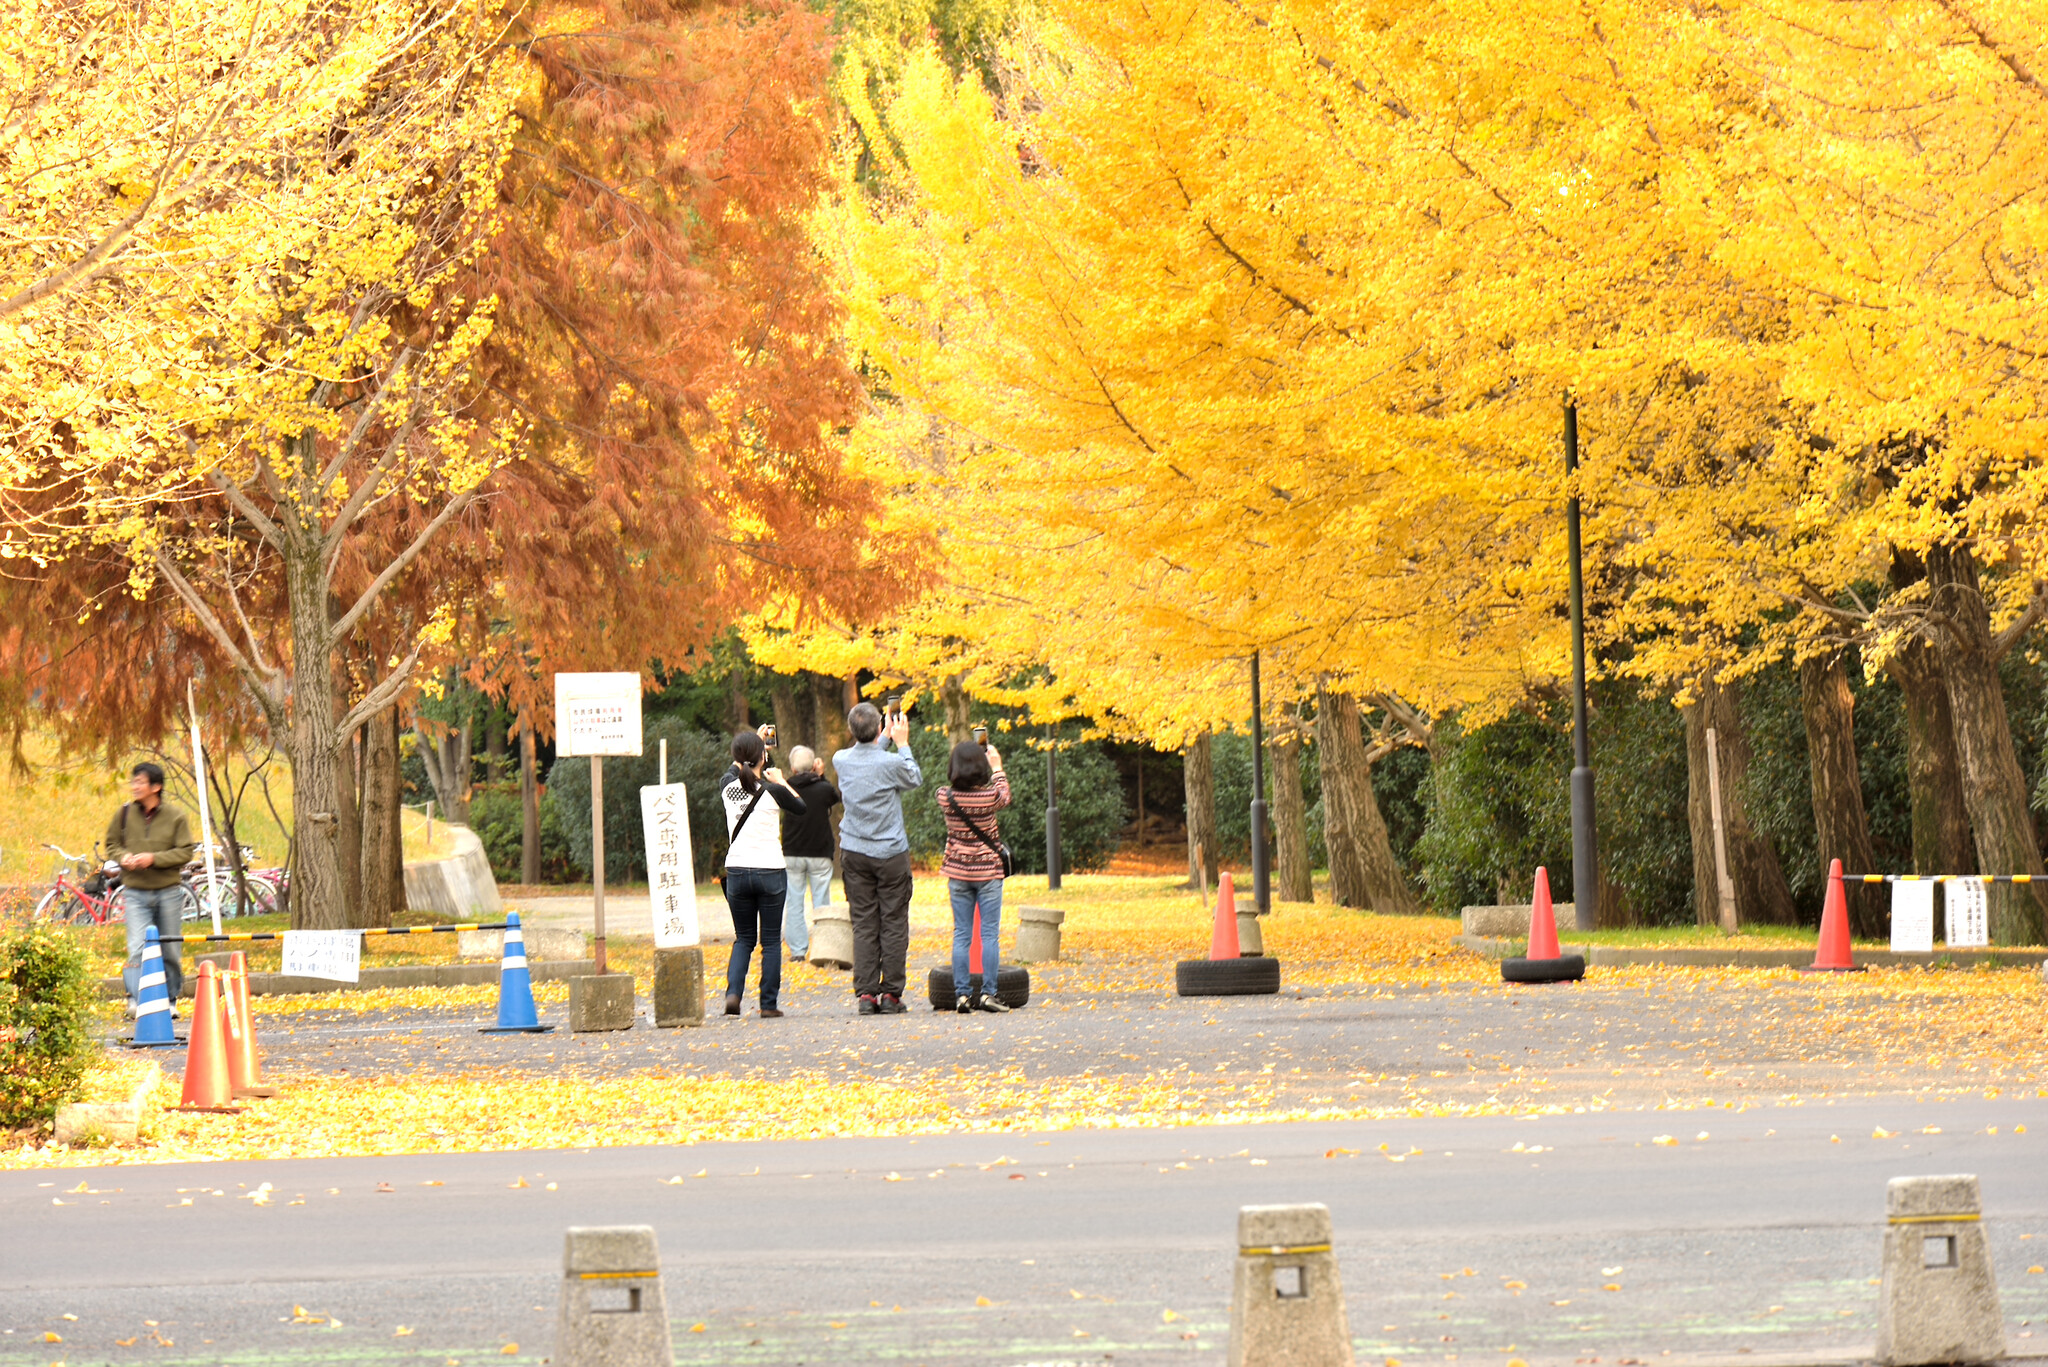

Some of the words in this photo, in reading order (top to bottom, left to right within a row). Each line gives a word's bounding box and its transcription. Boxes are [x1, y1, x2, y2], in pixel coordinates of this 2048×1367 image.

[653, 792, 685, 936] バス専用駐車場
